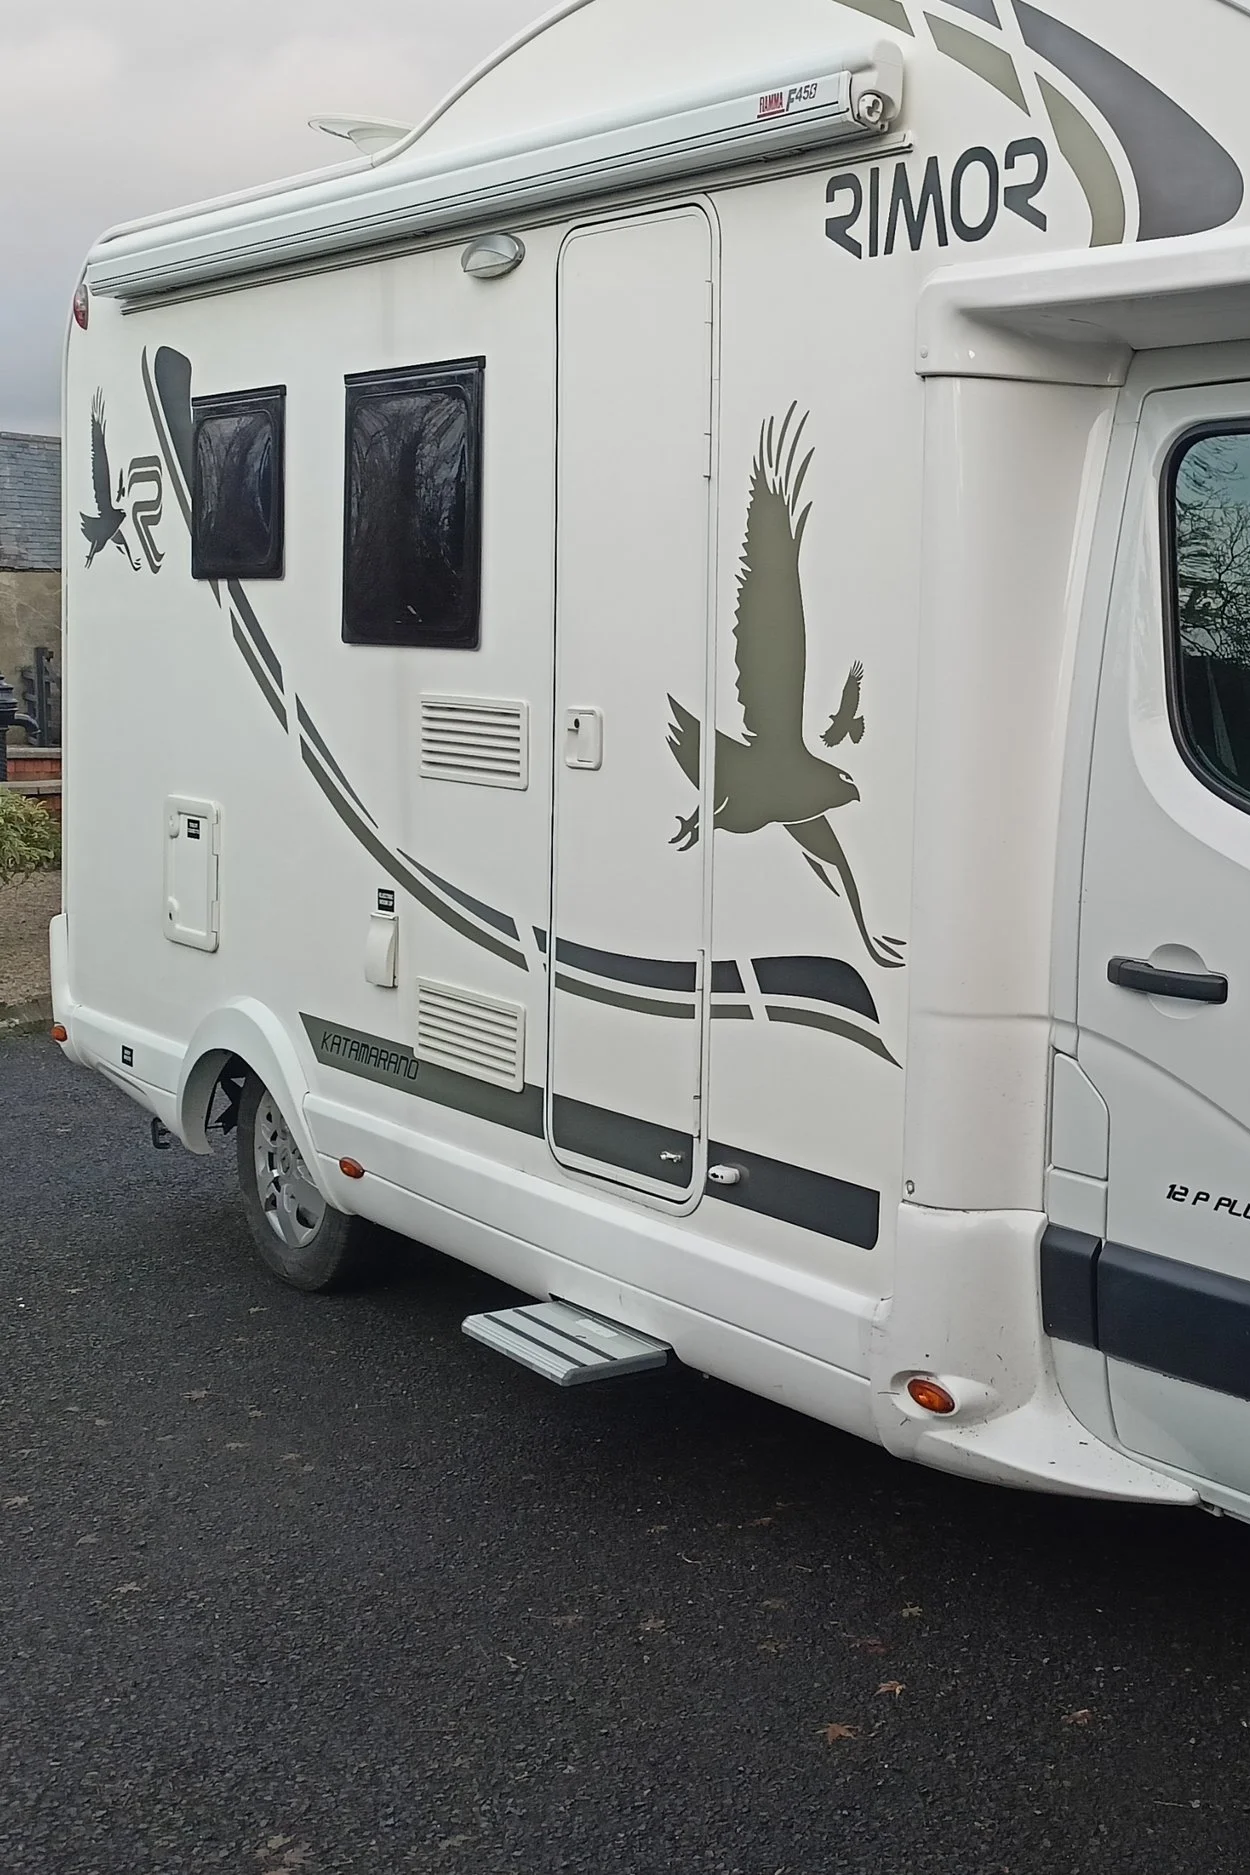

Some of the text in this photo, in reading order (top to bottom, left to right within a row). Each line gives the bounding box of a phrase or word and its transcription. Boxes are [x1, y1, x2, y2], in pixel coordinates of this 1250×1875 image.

[758, 91, 784, 114] FIAMMA
[825, 137, 1048, 260] RIMOR
[321, 1031, 420, 1080] KATAMARANO
[1166, 1184, 1189, 1203] 12
[1191, 1190, 1211, 1206] P
